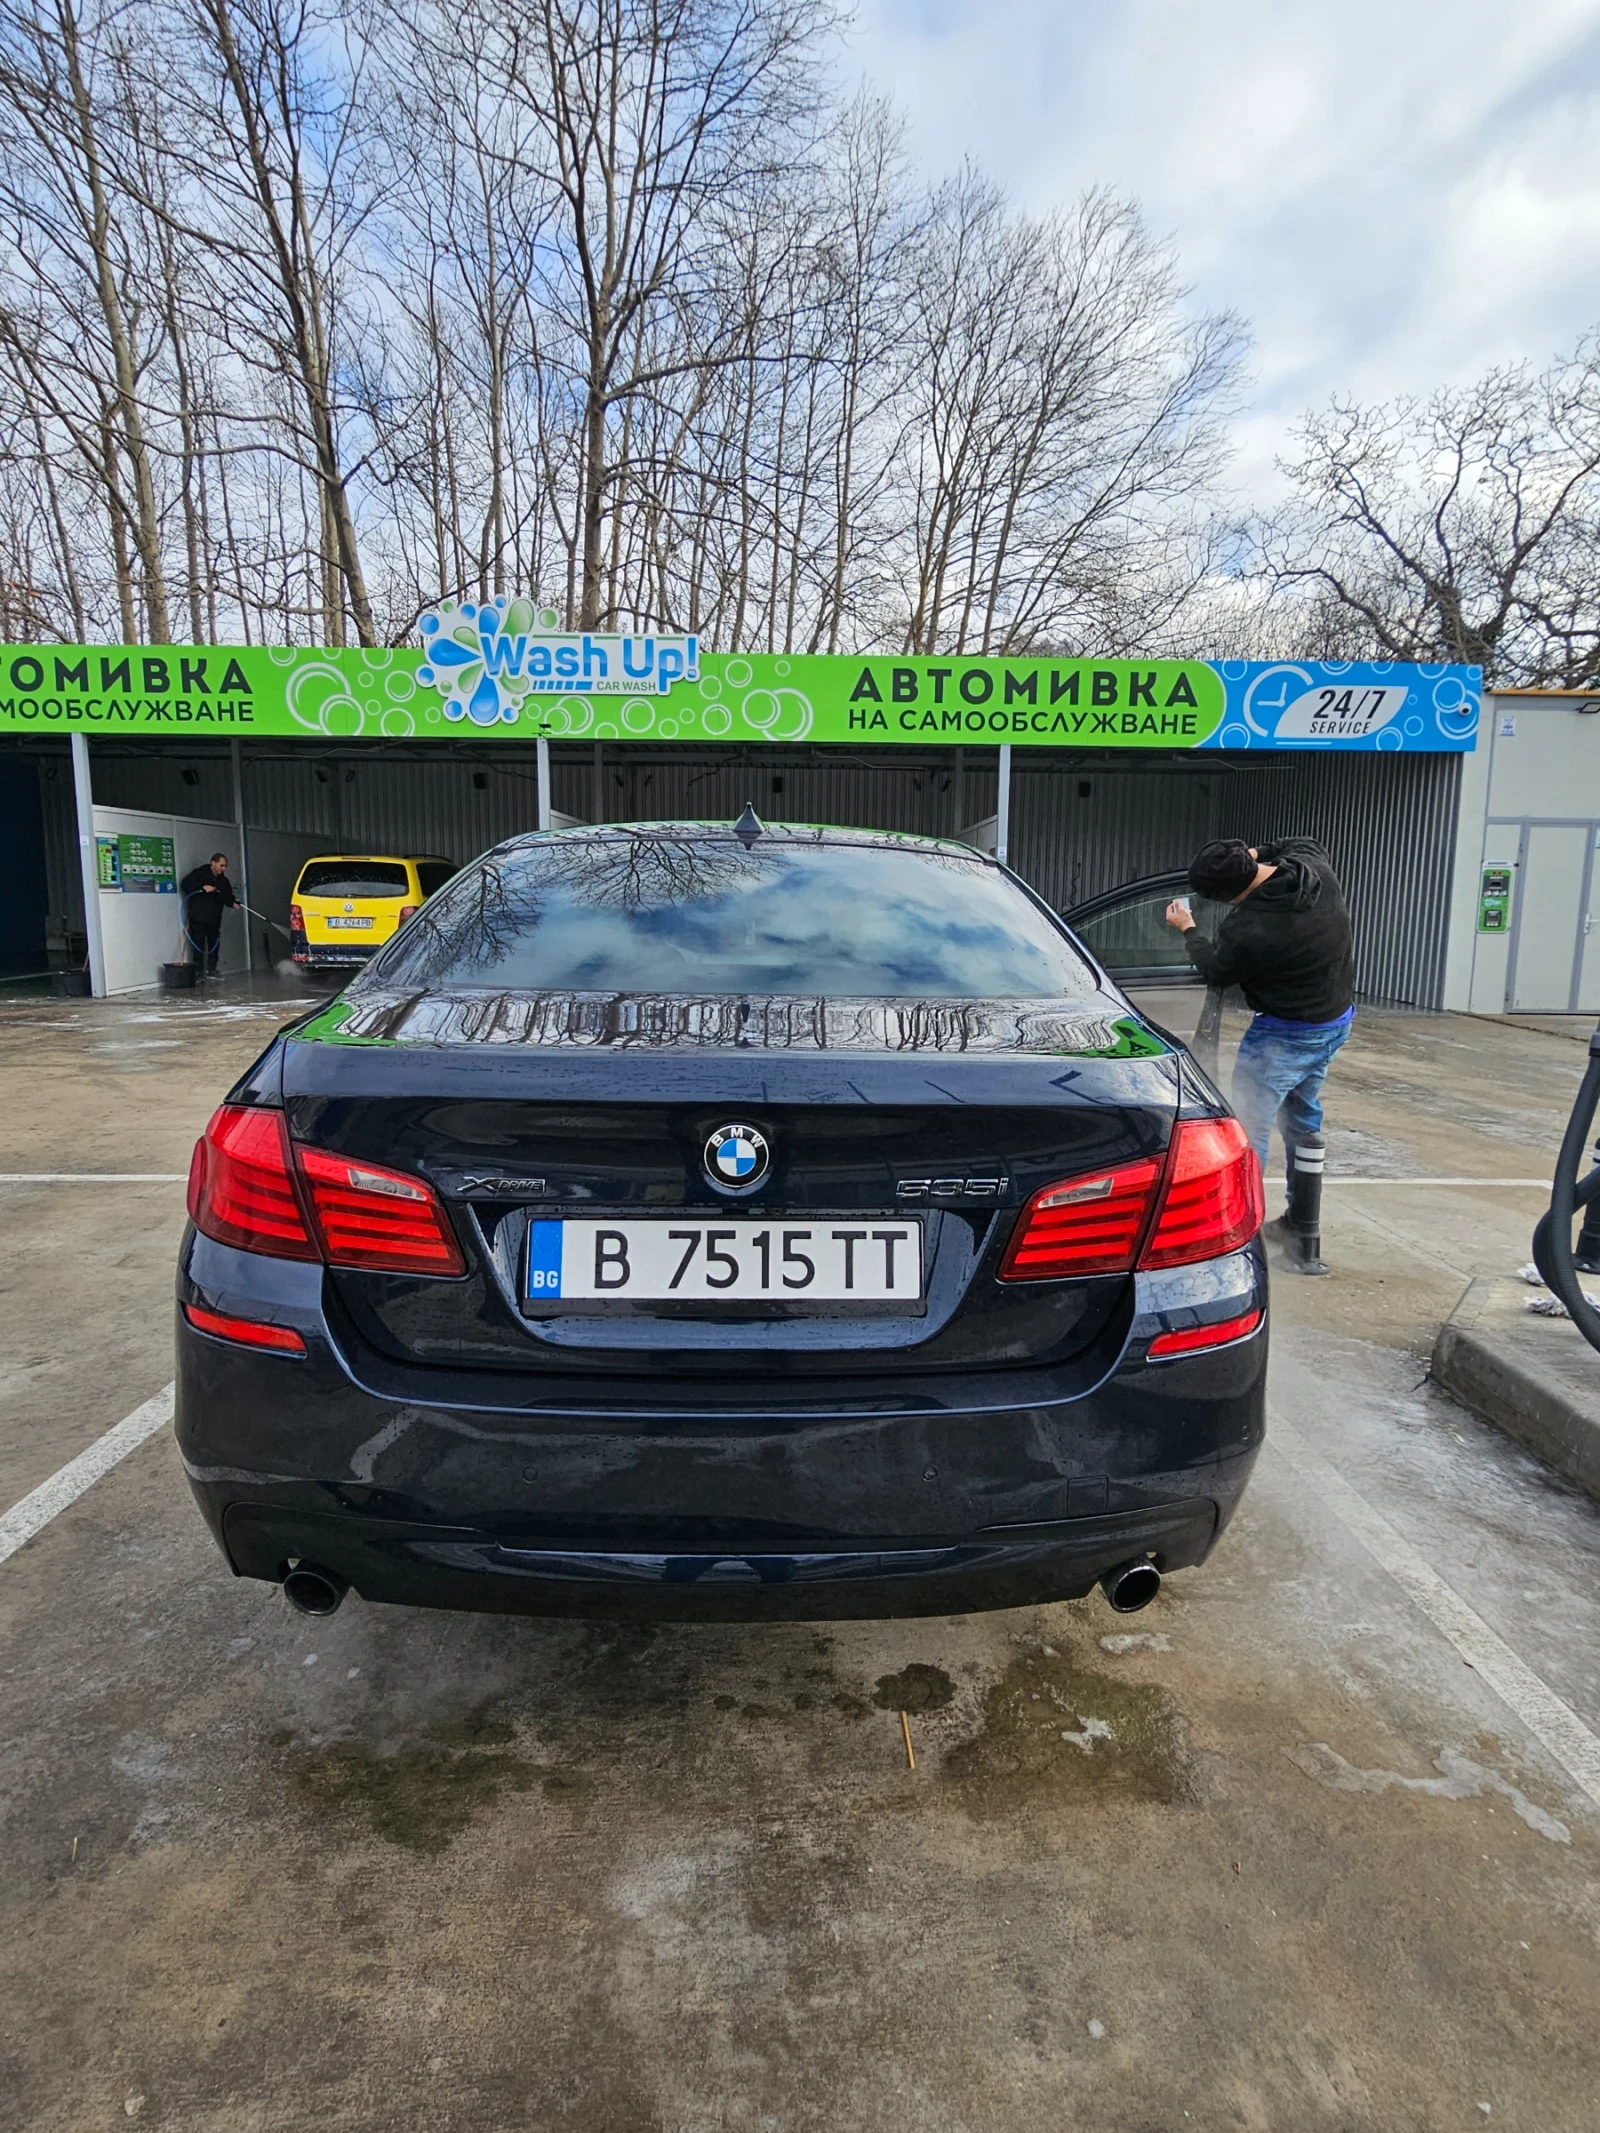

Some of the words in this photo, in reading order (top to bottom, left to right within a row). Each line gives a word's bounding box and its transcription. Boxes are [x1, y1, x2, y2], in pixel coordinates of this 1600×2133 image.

[0, 656, 253, 694] ОМИВКА
[480, 636, 608, 677] Wash
[623, 637, 697, 692] Up!
[596, 681, 620, 691] CAR
[622, 681, 656, 691] WASH
[849, 667, 1199, 707] АВТОМИВКА
[1313, 689, 1387, 719] 24/7
[849, 709, 888, 729] НА
[899, 710, 1197, 735] САМООБСЛУЖВАНЕ
[1309, 721, 1371, 734] SERVICE
[711, 1127, 764, 1148] BMW
[896, 1178, 1009, 1197] 535i
[594, 1230, 631, 1289] B
[668, 1230, 815, 1290] 7515
[832, 1231, 908, 1290] TT
[533, 1271, 558, 1289] BG
